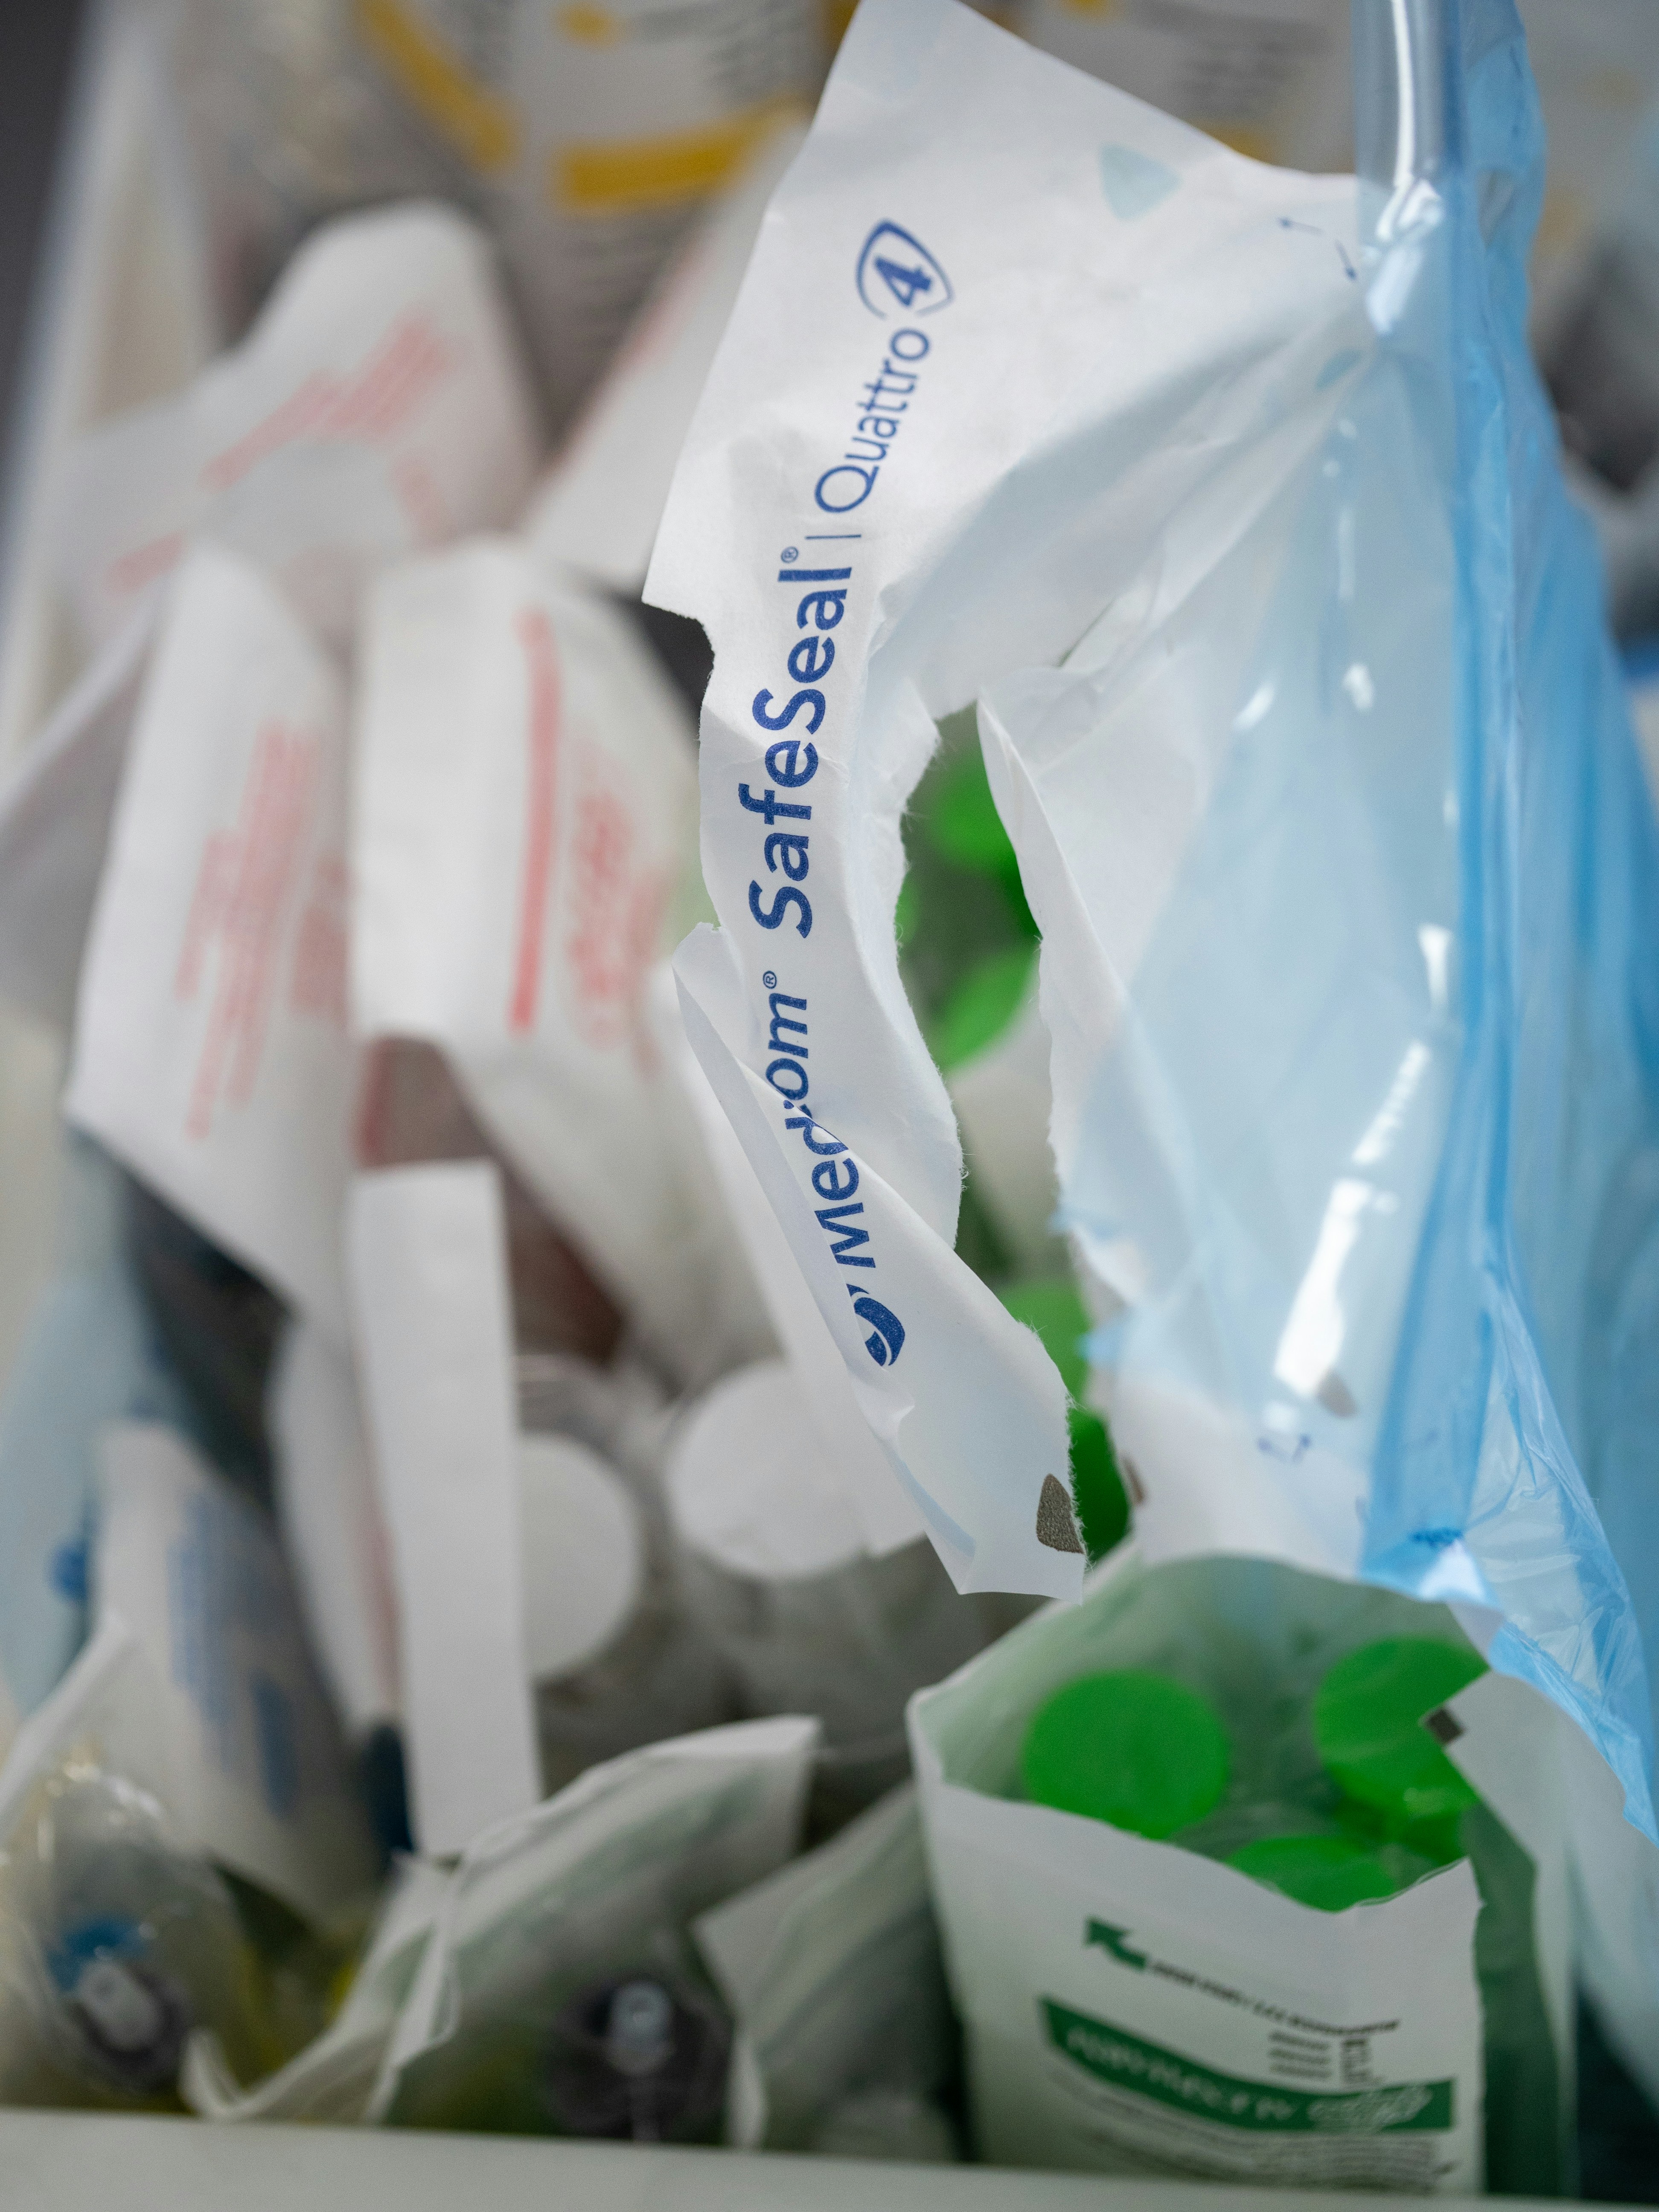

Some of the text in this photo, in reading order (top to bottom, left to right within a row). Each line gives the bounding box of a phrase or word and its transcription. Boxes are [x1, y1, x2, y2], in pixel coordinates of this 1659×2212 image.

[873, 254, 933, 307] 4
[814, 328, 931, 513] Quattro
[763, 970, 876, 1268] Medom®
